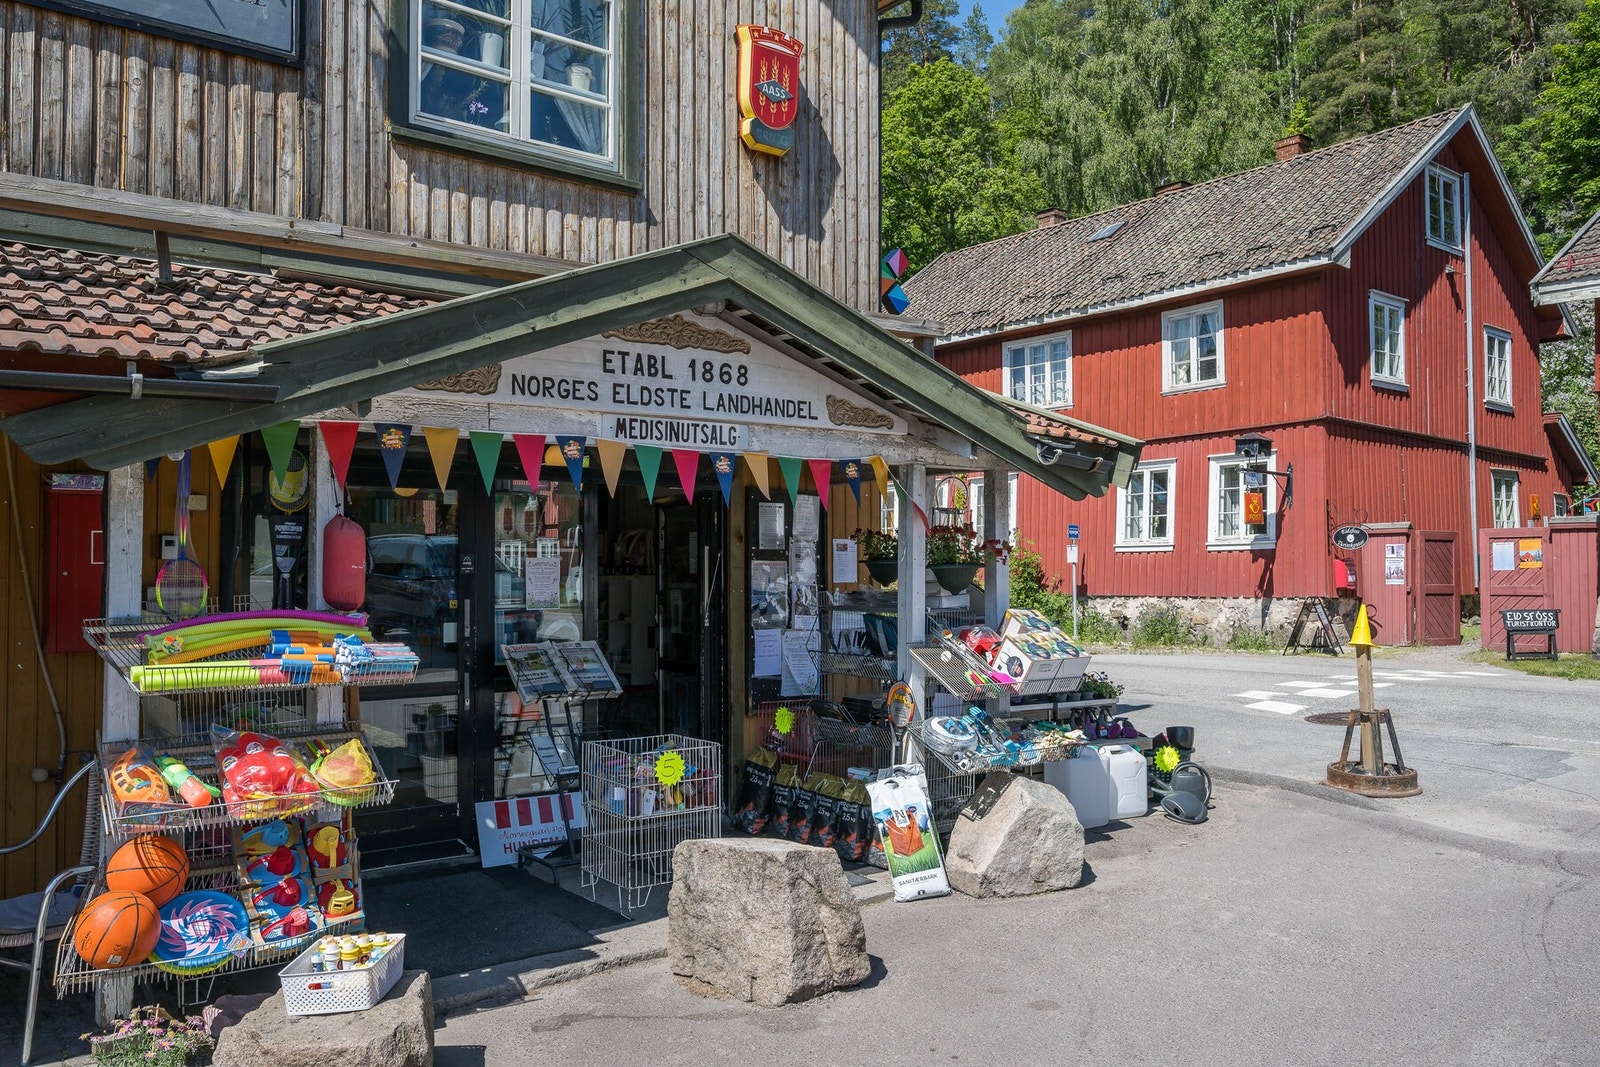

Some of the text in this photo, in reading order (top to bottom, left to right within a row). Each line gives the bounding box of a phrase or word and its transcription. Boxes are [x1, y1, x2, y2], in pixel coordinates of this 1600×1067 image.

[761, 84, 786, 99] AASS
[688, 358, 748, 387] 1868
[511, 373, 819, 421] NORGES ELDSTE LANDHANDEL
[615, 417, 737, 447] MEDISINUTSALG
[1505, 620, 1557, 628] TURISTKONTOR
[499, 827, 551, 840] Norwegian
[503, 835, 568, 855] HUNDEMA
